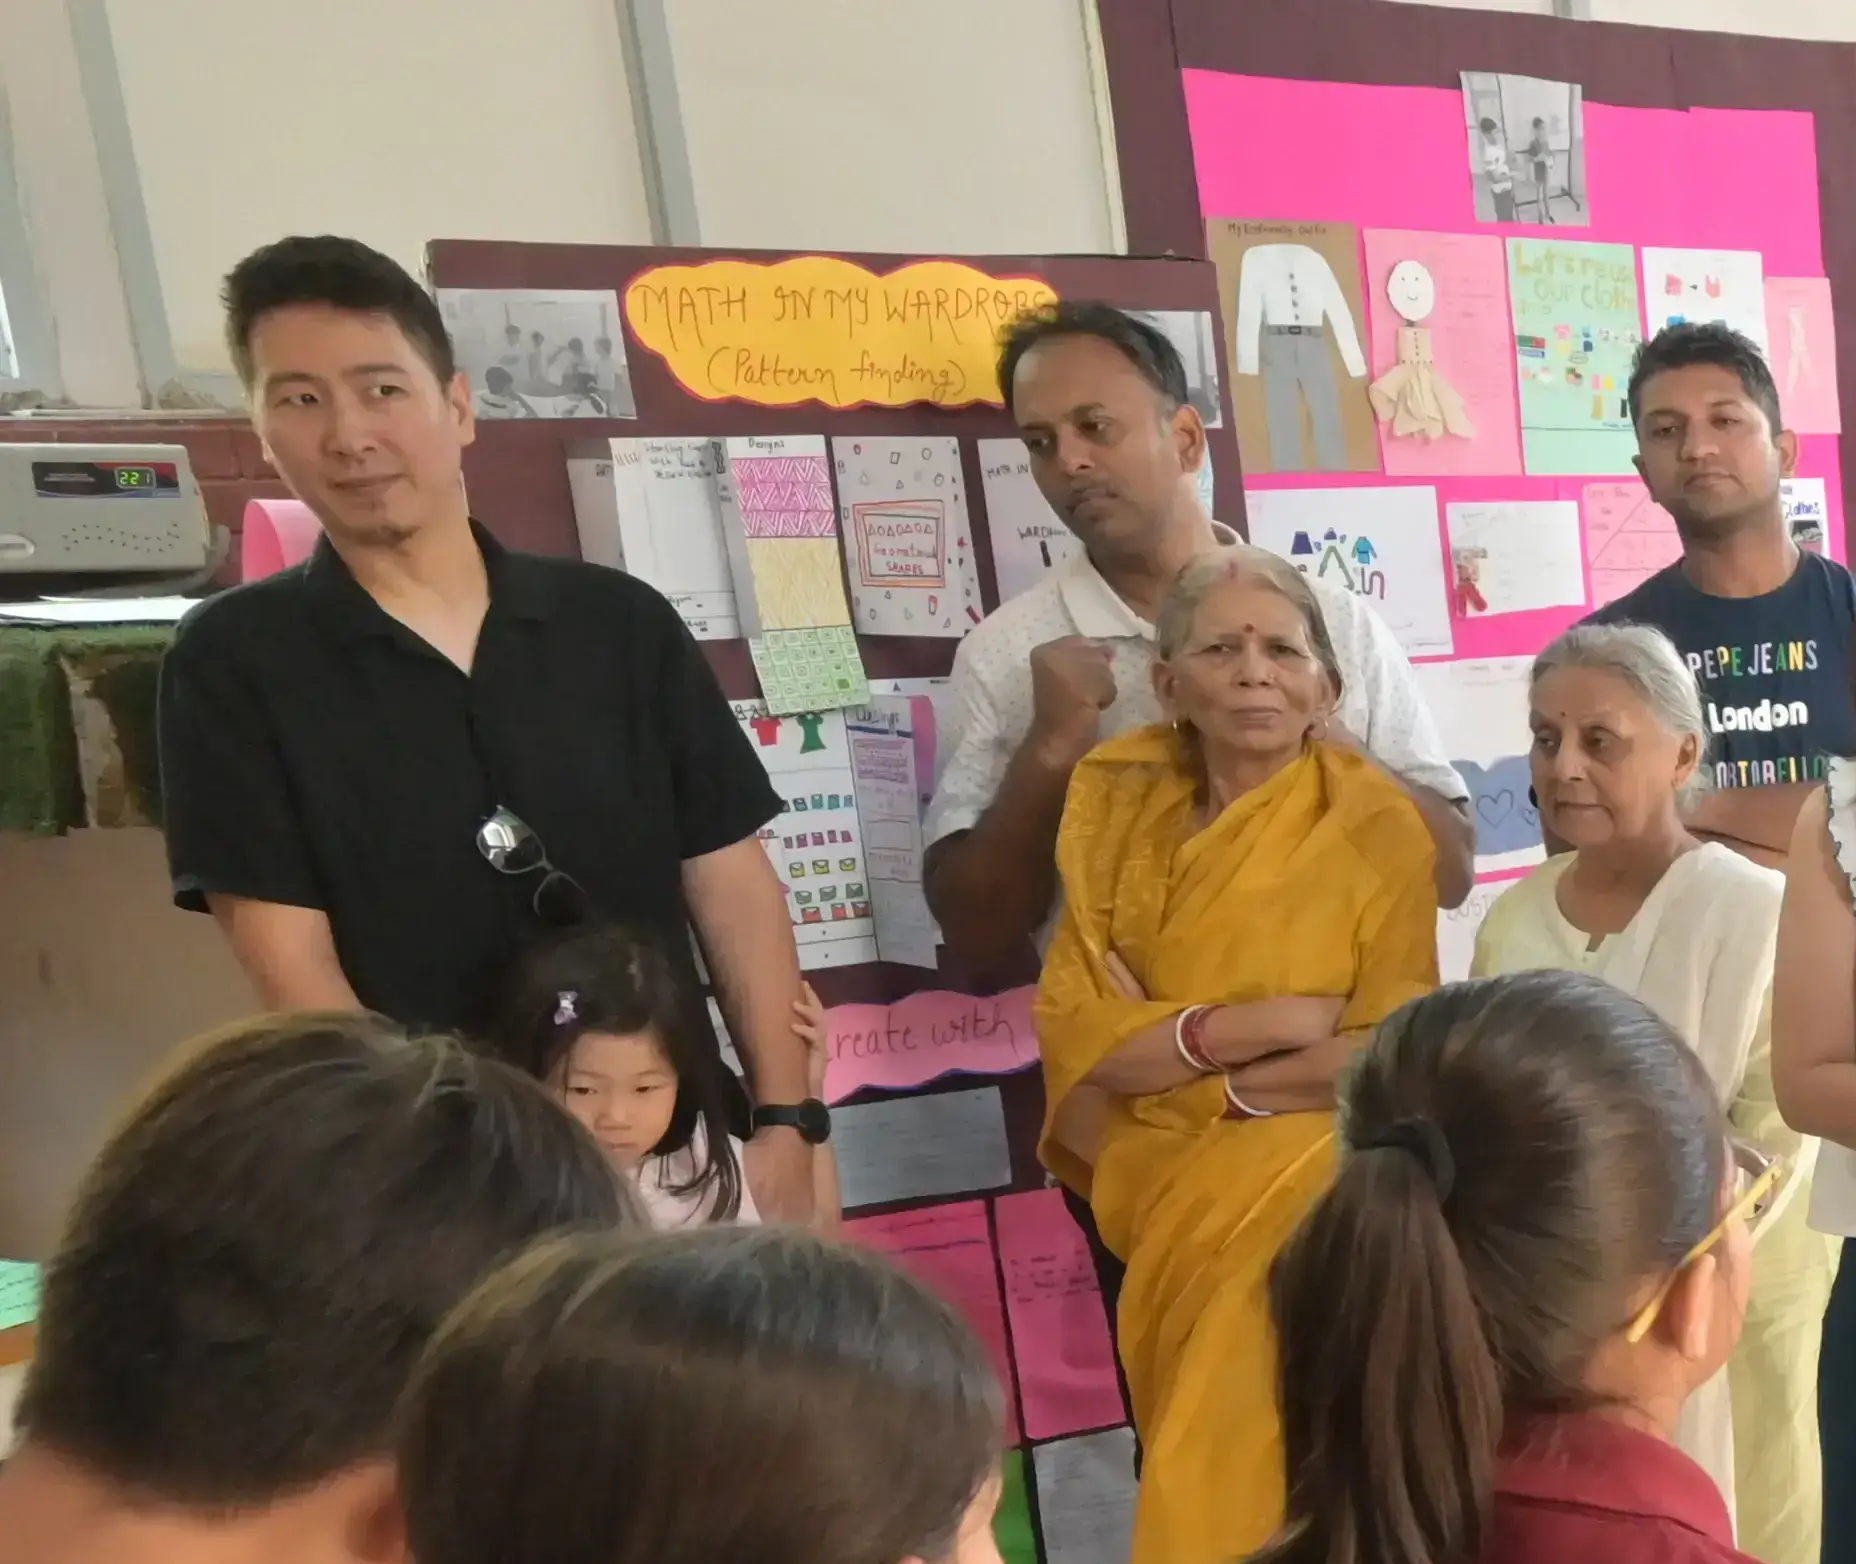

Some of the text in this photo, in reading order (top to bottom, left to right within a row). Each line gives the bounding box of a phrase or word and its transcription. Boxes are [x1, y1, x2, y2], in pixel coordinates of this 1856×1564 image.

[632, 284, 746, 351] MATH
[824, 287, 869, 338] MY
[707, 346, 966, 404] (Pattern finding)
[1686, 639, 1820, 680] PEPE JEANS
[1708, 698, 1809, 734] London
[828, 1009, 917, 1061] reate
